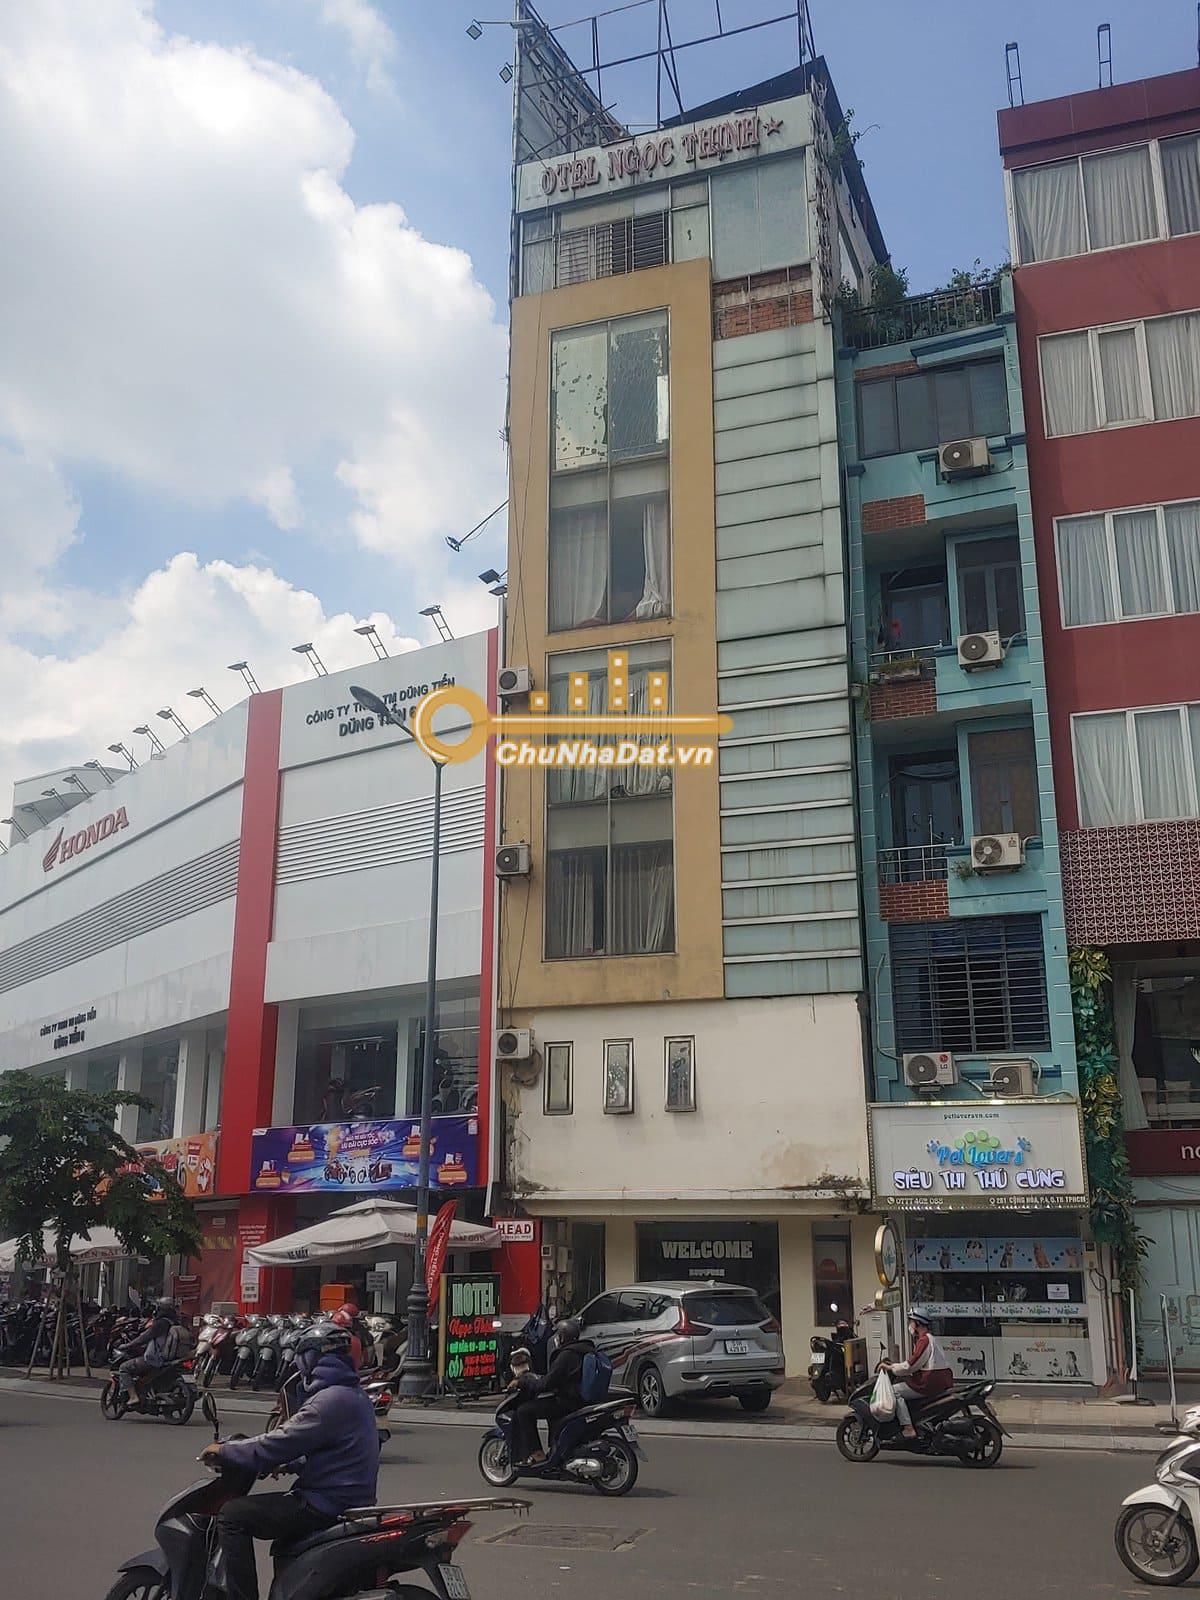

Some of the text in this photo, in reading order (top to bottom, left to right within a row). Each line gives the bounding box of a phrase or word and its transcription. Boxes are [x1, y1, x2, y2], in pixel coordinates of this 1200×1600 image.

[682, 115, 761, 162] THỊNH
[306, 710, 334, 725] CÔNG
[337, 704, 350, 717] TY
[382, 692, 397, 704] TM
[400, 684, 428, 701] DŨNG
[339, 716, 374, 737] DŨNG
[59, 806, 129, 865] HONDA
[937, 1146, 1024, 1168] Pet Lovers
[893, 1167, 933, 1189] SIÊU
[498, 1223, 532, 1235] HEAD
[661, 1240, 753, 1259] WELCOME
[452, 1282, 496, 1317] HOTEL
